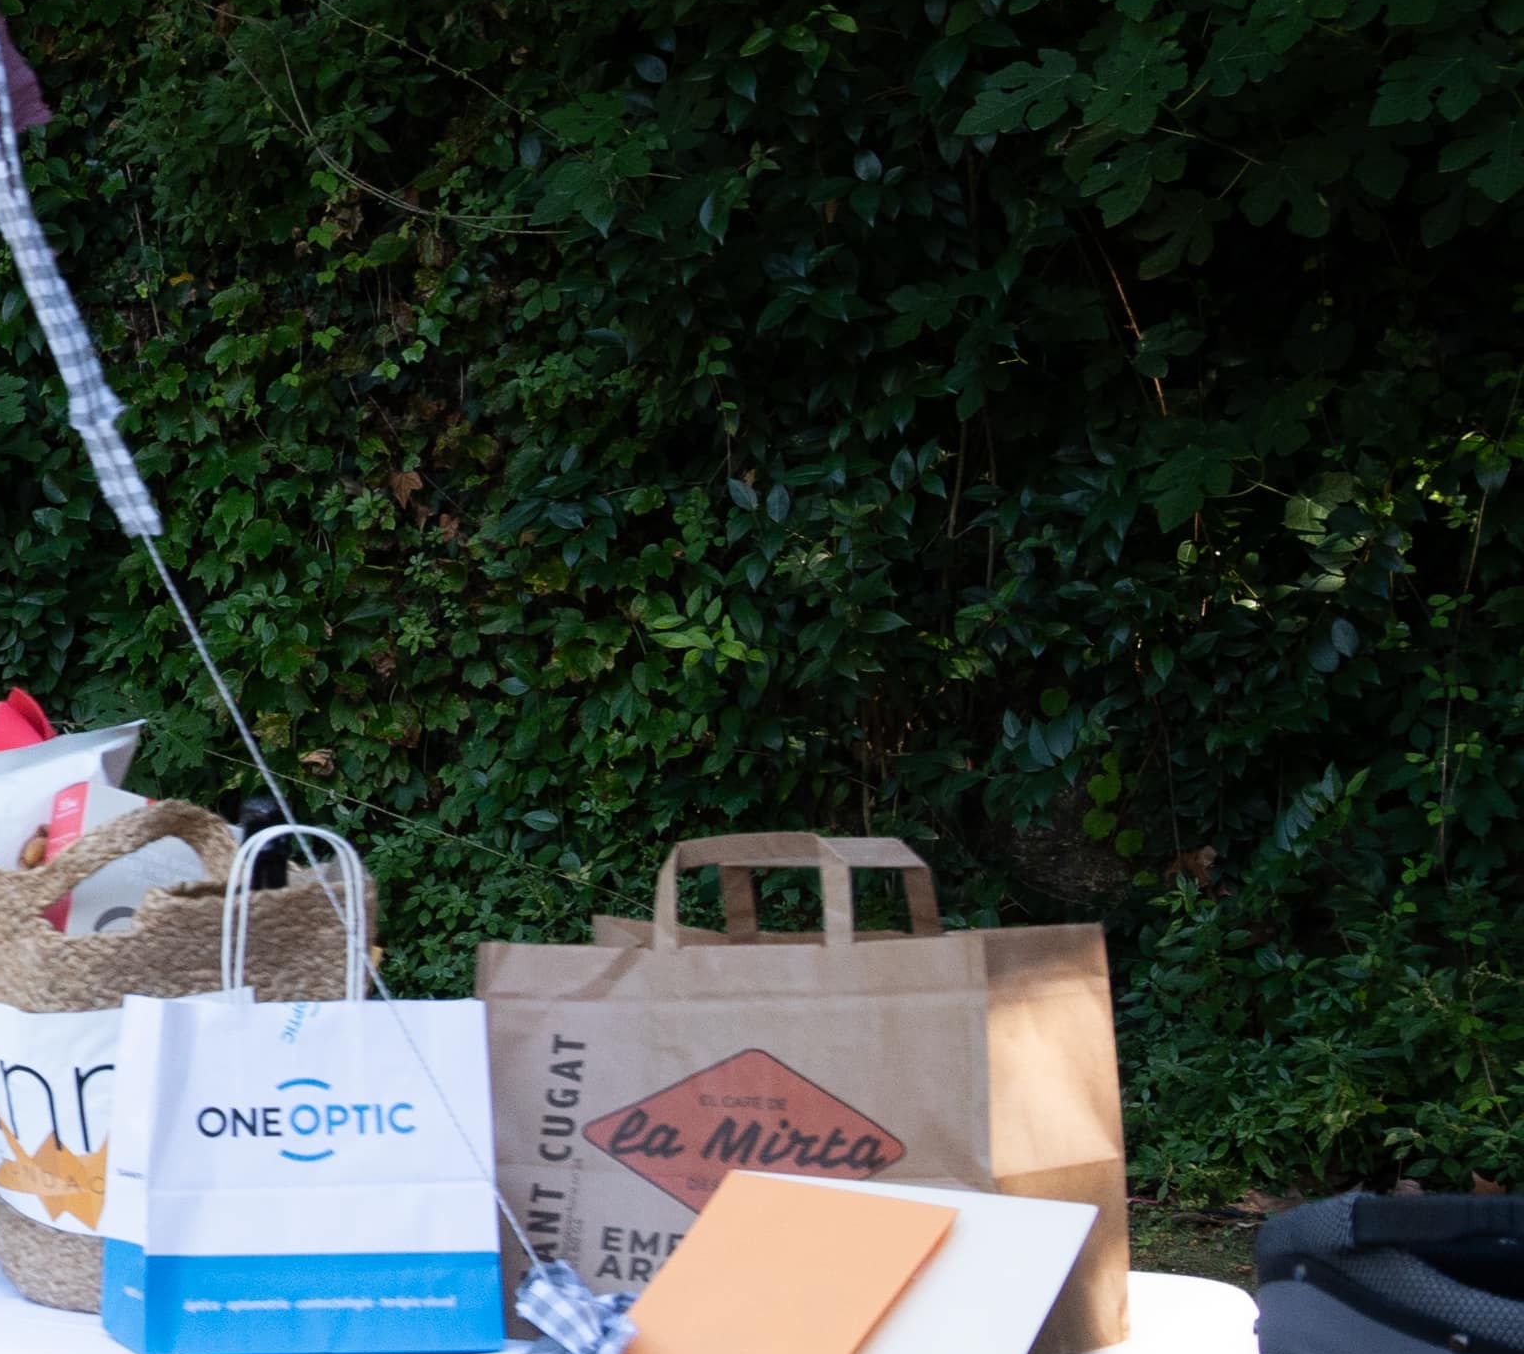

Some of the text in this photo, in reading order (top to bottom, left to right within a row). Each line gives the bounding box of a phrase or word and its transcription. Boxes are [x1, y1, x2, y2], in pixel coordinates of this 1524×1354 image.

[538, 1033, 587, 1162] CUGAT
[609, 1108, 886, 1169] la Mirta
[524, 1182, 564, 1264] ANT
